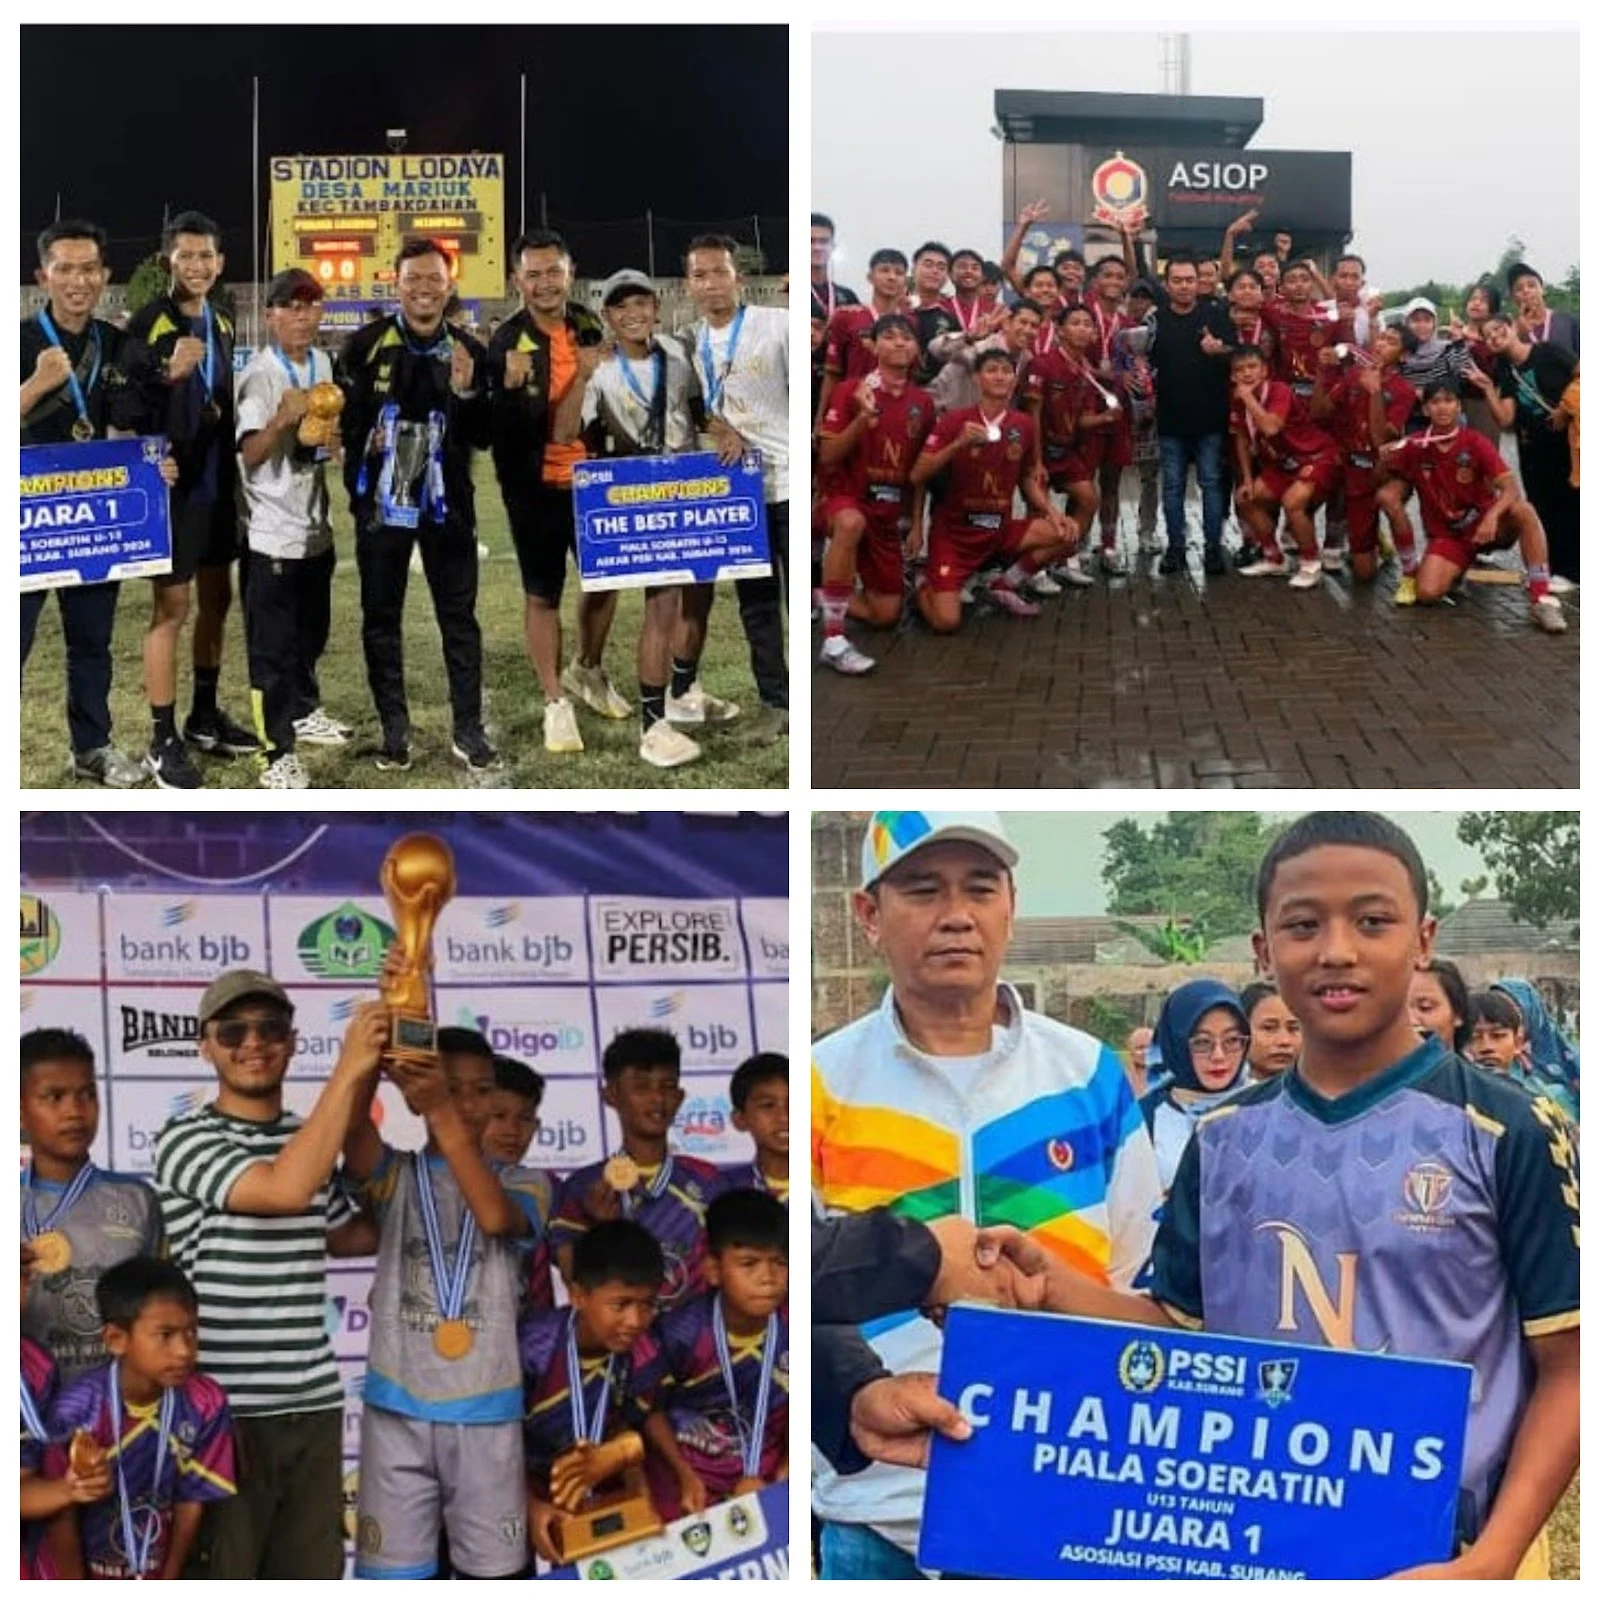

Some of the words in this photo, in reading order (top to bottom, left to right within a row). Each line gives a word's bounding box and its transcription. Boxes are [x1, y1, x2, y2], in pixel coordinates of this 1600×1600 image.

[274, 158, 389, 181] STADION
[402, 157, 500, 179] LODAYA
[1168, 162, 1268, 190] ASIOP
[302, 182, 363, 199] DESA
[383, 180, 471, 198] MARIUK
[341, 198, 477, 212] TAMBAKDAHAN
[608, 478, 730, 504] CHAMPIONS
[106, 499, 118, 519] 1
[593, 516, 628, 535] THE
[635, 511, 677, 532] BEST
[684, 505, 751, 527] PLAYER
[604, 910, 727, 932] EXPLORE
[120, 933, 191, 961] bank
[200, 935, 250, 967] bjb
[446, 937, 518, 963] bank
[523, 935, 573, 966] bjb
[608, 932, 731, 964] PERSIB.
[760, 936, 788, 959] ba
[121, 1004, 199, 1043] BAND
[492, 1027, 585, 1057] DigoID
[688, 1025, 738, 1053] bjb
[128, 1125, 157, 1150] ba
[537, 1120, 587, 1150] bjb
[1168, 1349, 1247, 1385] PSSI
[958, 1383, 1445, 1480] CHAMPIONS
[1033, 1441, 1145, 1486] PIALA
[1154, 1457, 1345, 1508] SOERATIN
[1147, 1492, 1175, 1509] U13
[1180, 1496, 1235, 1515] TAHUN
[1105, 1509, 1231, 1551] JUARA
[1244, 1525, 1262, 1555] 1
[1059, 1544, 1142, 1568] ASOSIASI
[1145, 1554, 1181, 1573] PSSI
[1186, 1559, 1227, 1579] KAB.
